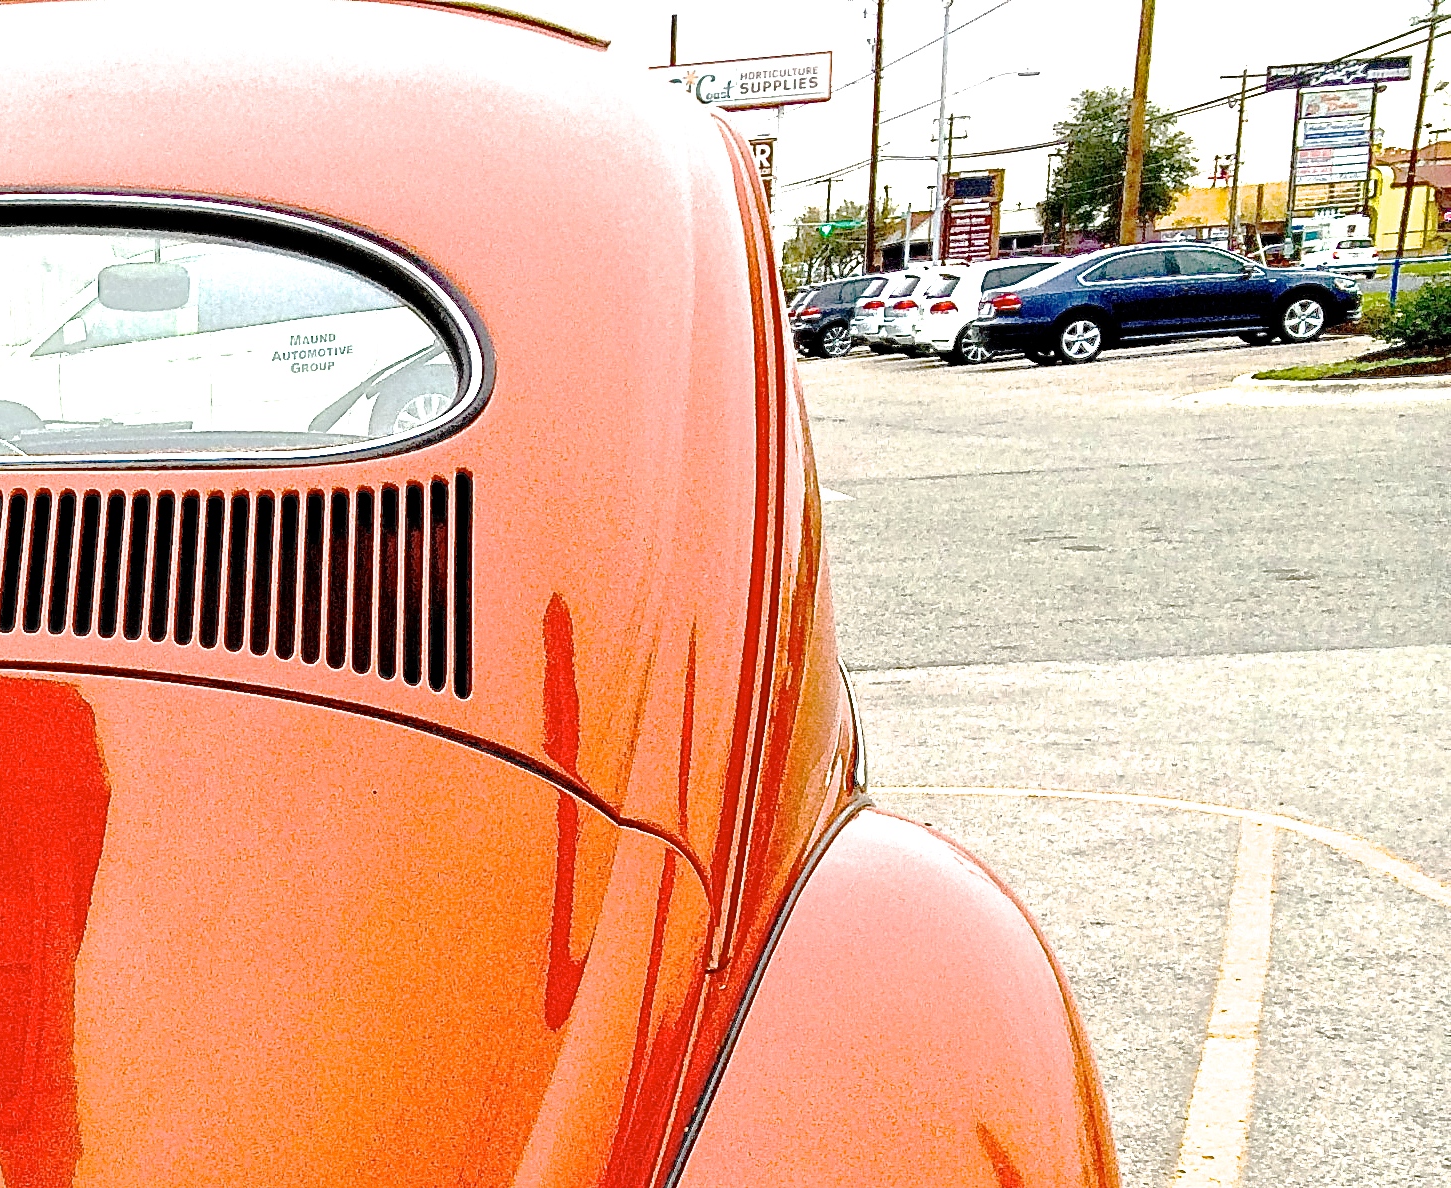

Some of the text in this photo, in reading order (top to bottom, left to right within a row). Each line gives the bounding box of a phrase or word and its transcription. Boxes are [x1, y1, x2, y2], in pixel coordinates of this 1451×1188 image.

[740, 66, 818, 81] HORTICULTURE
[696, 75, 735, 103] Coast
[740, 77, 818, 95] SUPPLIES
